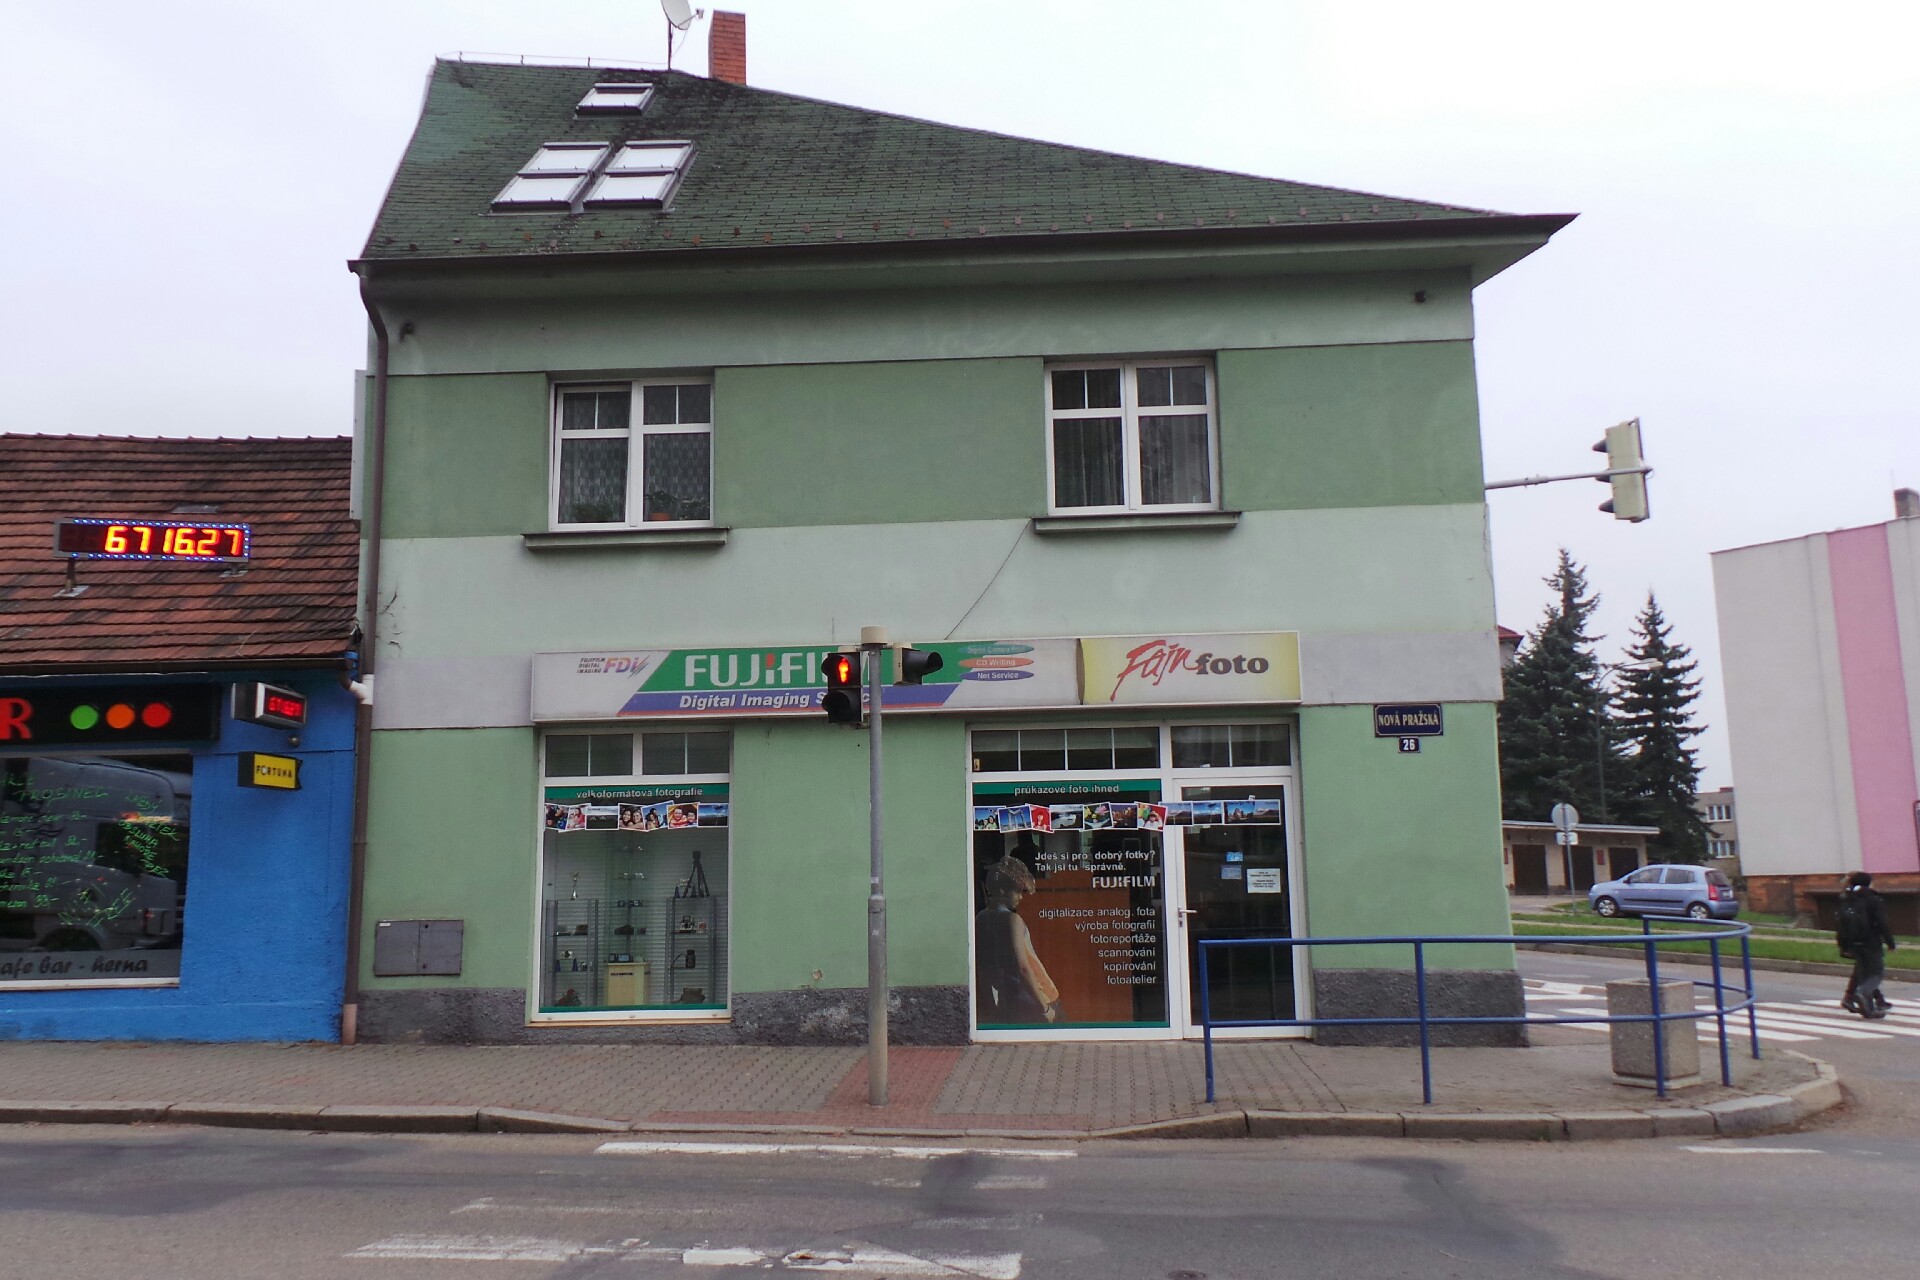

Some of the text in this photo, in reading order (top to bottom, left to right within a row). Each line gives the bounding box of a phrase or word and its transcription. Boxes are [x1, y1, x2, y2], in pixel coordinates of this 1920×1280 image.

[976, 658, 1016, 667] CD Writing
[1195, 653, 1269, 675] foto
[991, 671, 1019, 679] Service
[679, 694, 736, 711] Digital
[741, 692, 810, 710] Imaging
[1378, 709, 1439, 726] NOVÁ PRAŽSKÁ
[1403, 739, 1416, 751] 26
[256, 764, 293, 778] FORTUNA
[655, 787, 703, 798] fotografie
[1069, 785, 1089, 793] foto
[1091, 784, 1120, 793] ihned
[1034, 850, 1156, 861] Jdeš si pro dobrý fotky?
[1034, 863, 1051, 871] Tak
[1053, 863, 1066, 873] jsi
[1092, 876, 1156, 888] FUJIFILM
[1039, 908, 1094, 919] digitalizace
[1136, 907, 1156, 916] fota
[1075, 921, 1109, 932] výroba
[1090, 932, 1156, 944] fotoreportáže
[0, 957, 33, 978] afe
[39, 955, 73, 974] bar
[92, 954, 149, 973] herna
[1107, 975, 1157, 985] fotoatelier
